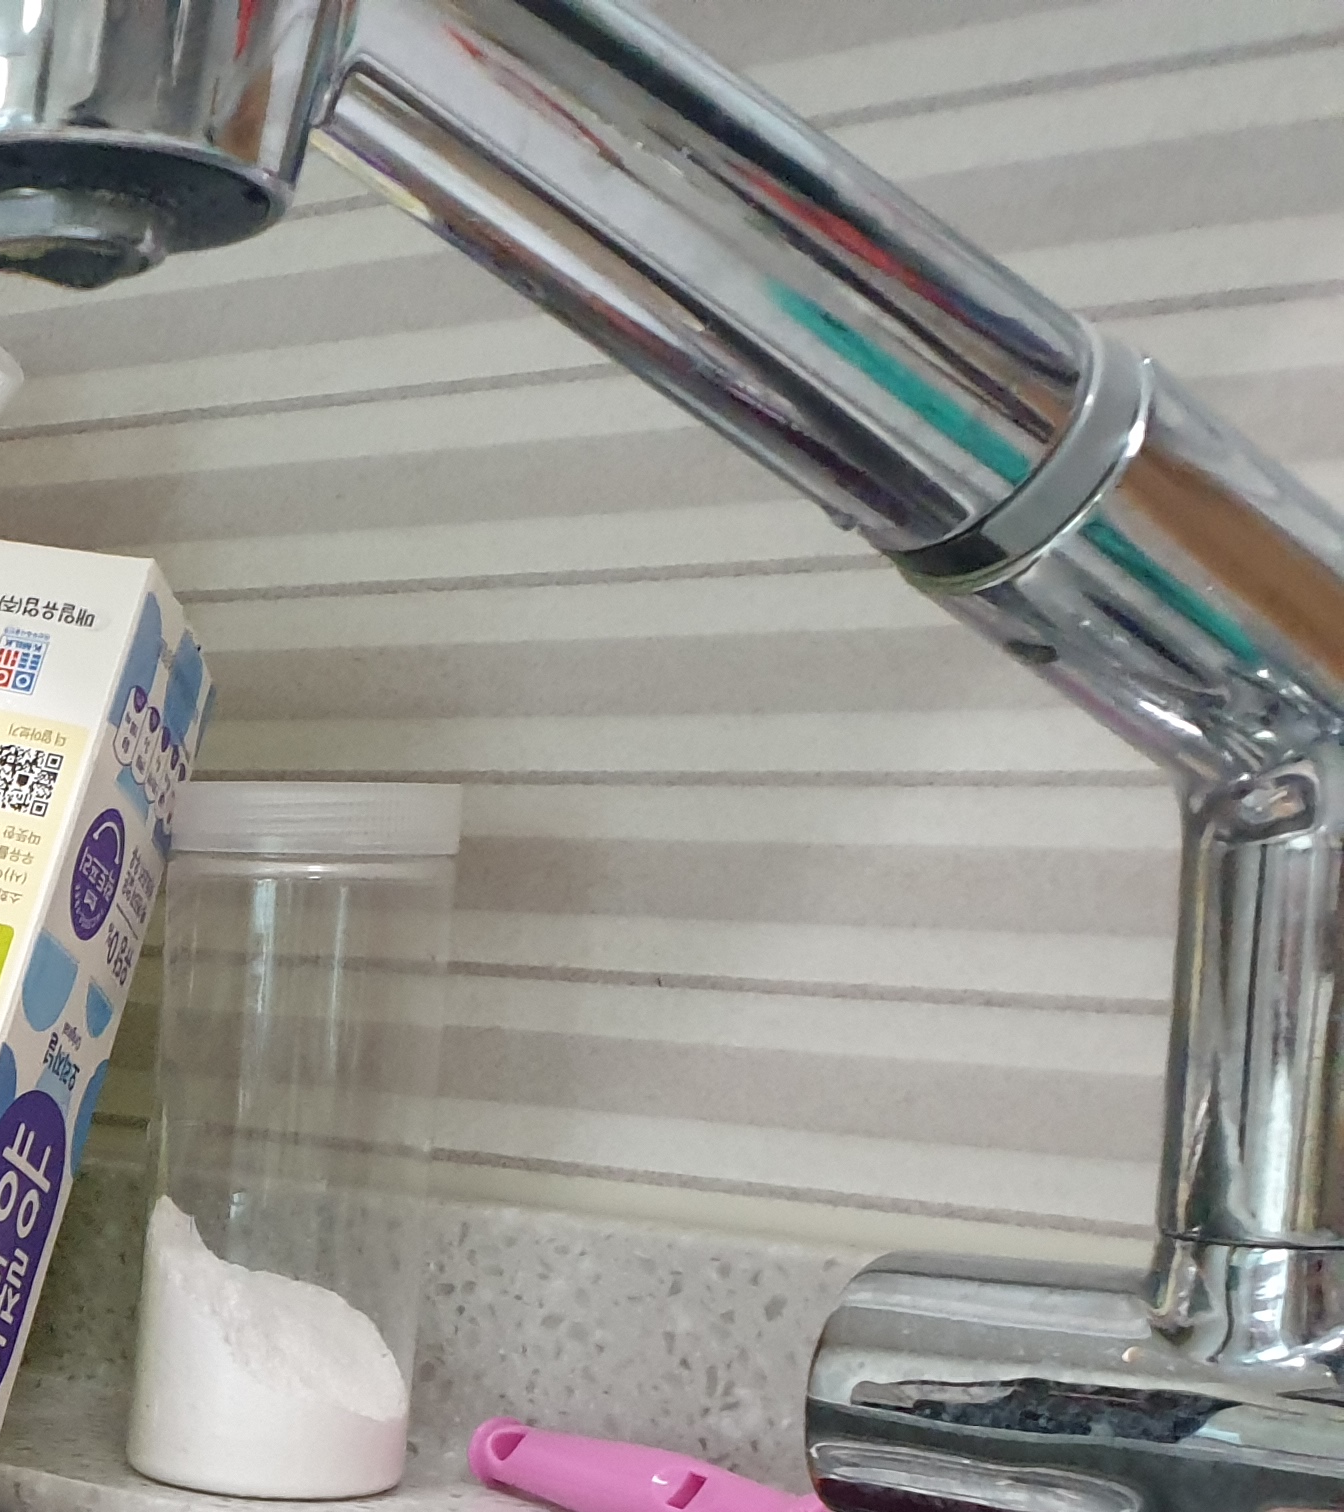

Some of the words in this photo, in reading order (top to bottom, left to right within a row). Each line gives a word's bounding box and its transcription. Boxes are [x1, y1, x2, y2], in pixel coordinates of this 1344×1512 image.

[7, 723, 53, 745] 알아보기
[54, 734, 67, 747] 더
[3, 824, 42, 847] 따뜻한
[41, 1030, 81, 1092] 오리지널
